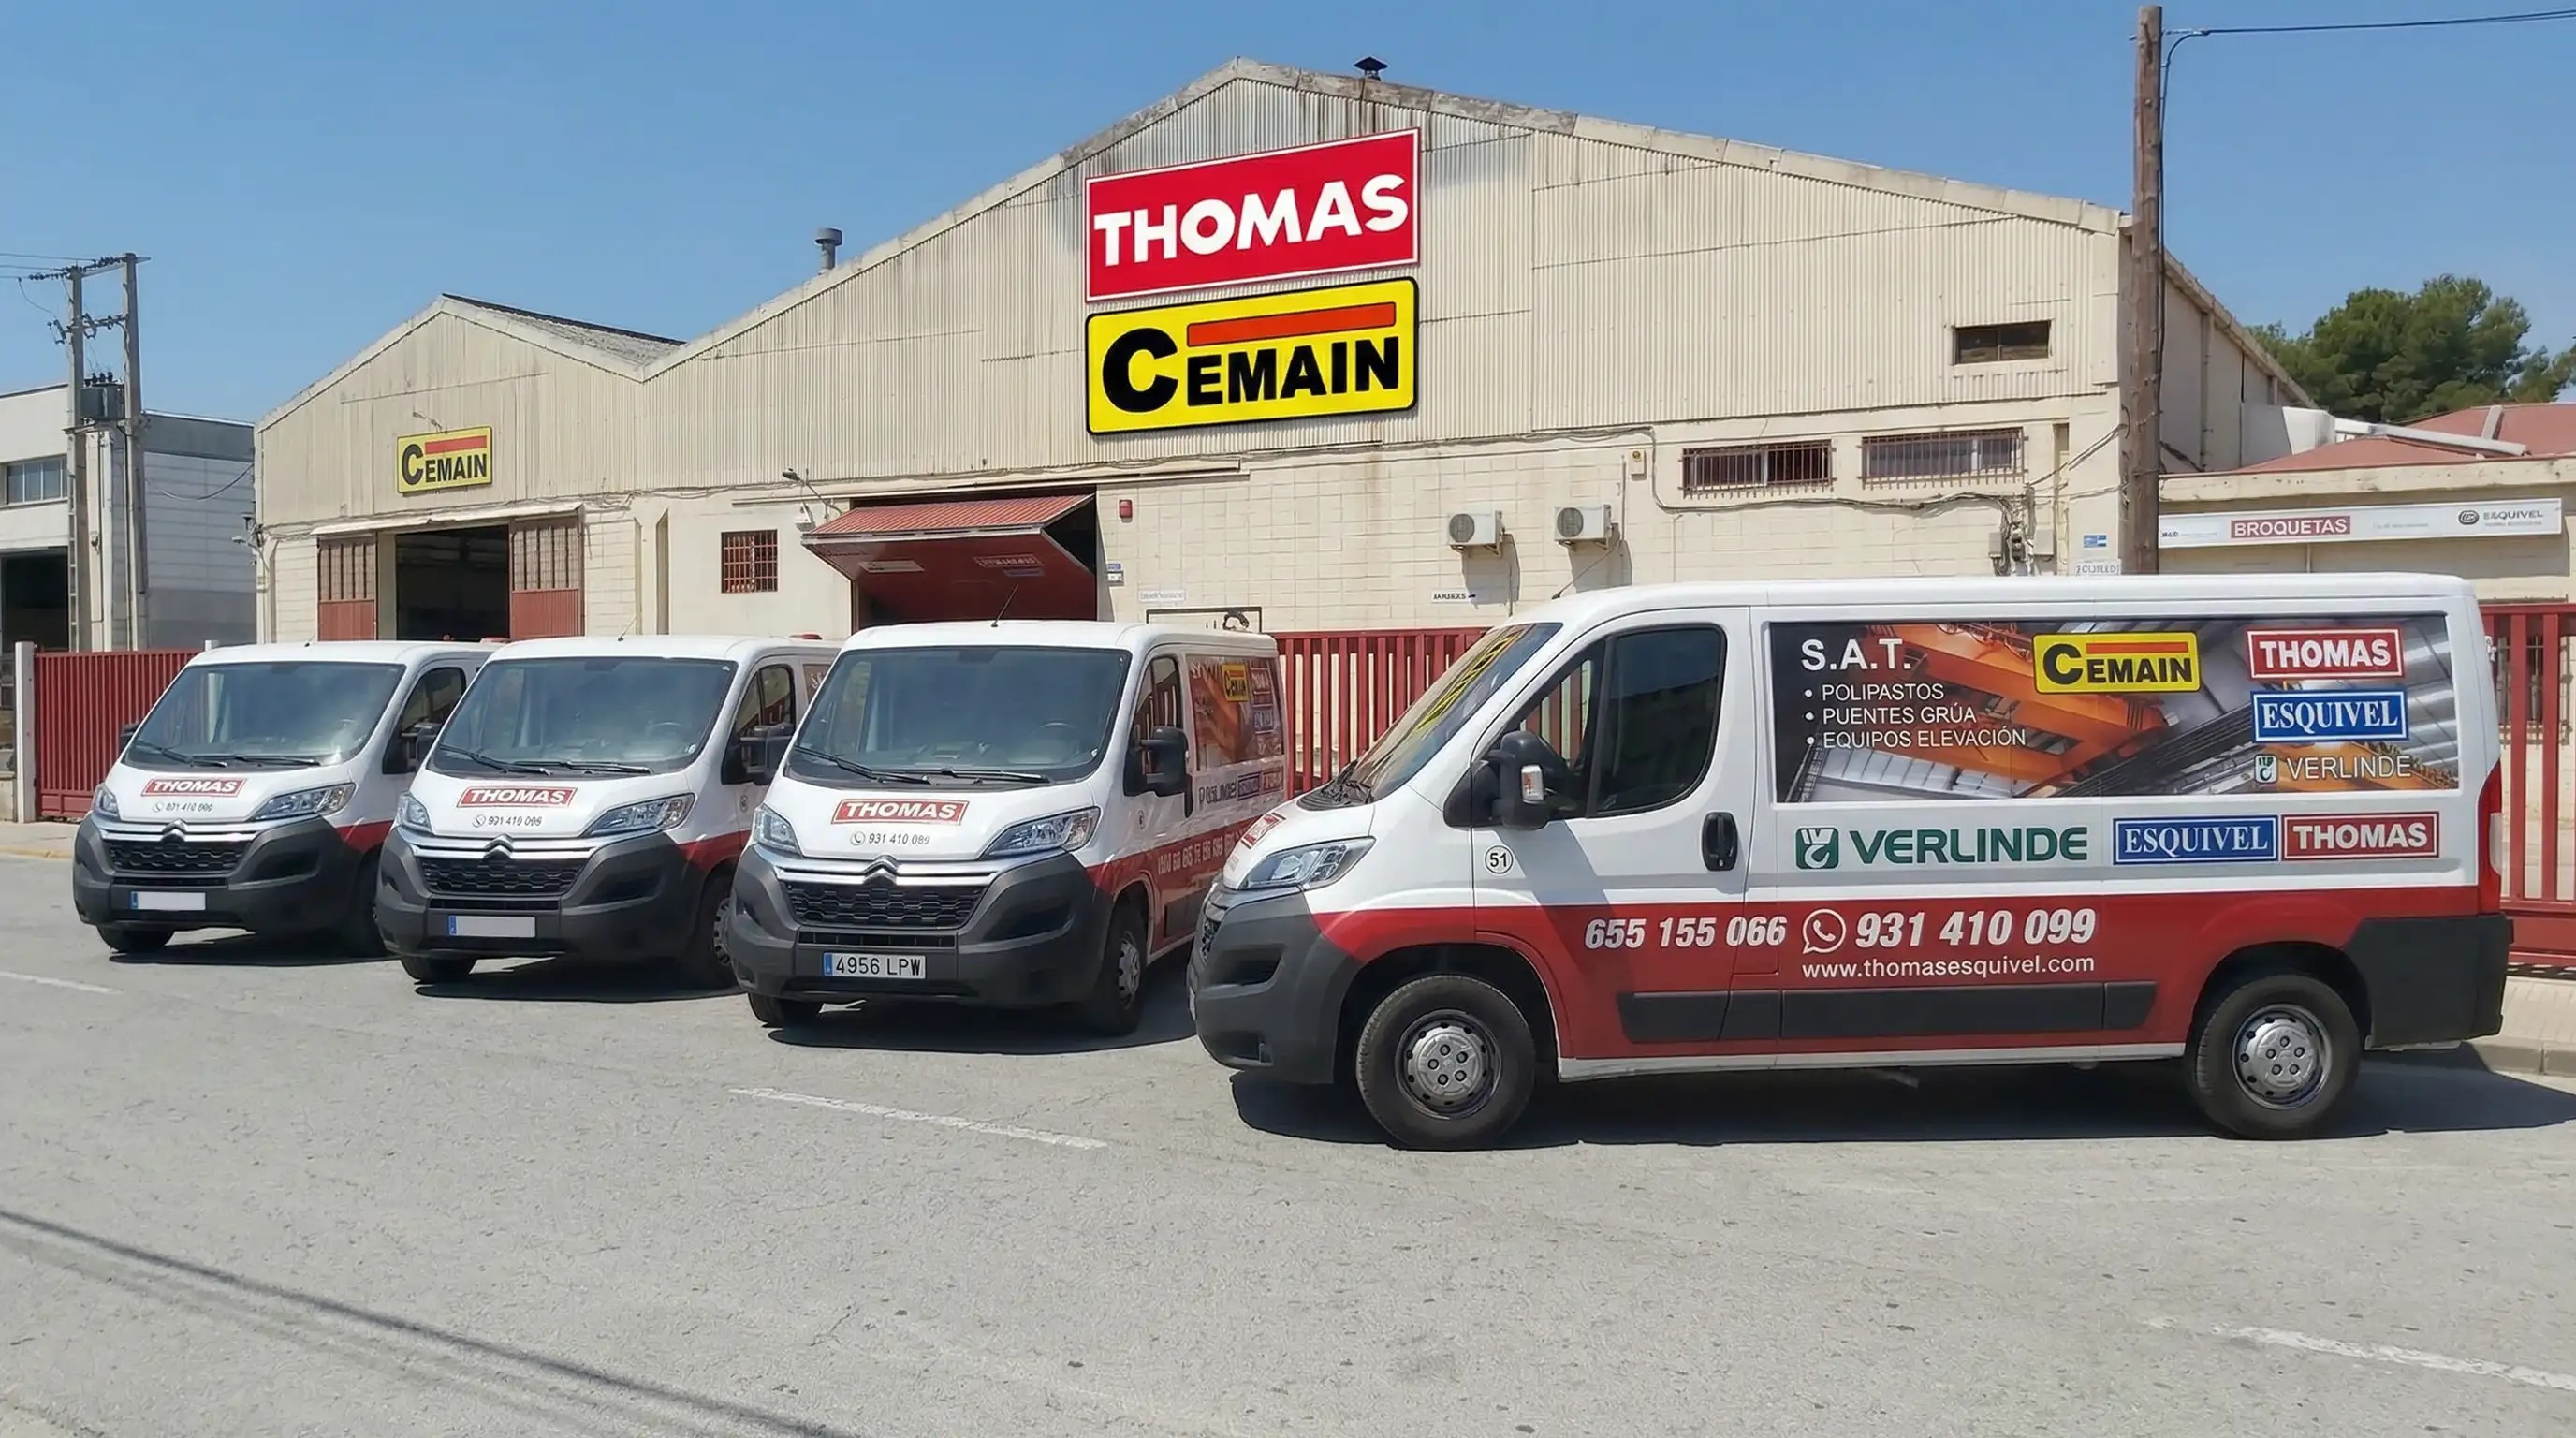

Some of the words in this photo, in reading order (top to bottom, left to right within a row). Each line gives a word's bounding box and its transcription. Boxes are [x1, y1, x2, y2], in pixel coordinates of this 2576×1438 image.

[1093, 174, 1409, 267] THOMAS
[1102, 327, 1399, 414] CEMAIN
[401, 443, 488, 486] CEMAIN
[2233, 518, 2349, 537] BROQUETAS
[1801, 638, 1911, 672] S.A.T.
[2042, 642, 2193, 686] CEMAIN
[2259, 638, 2392, 668] THOMAS
[1822, 683, 1945, 702] POLIPASTOS
[1822, 707, 1915, 725] PUENTES
[1920, 702, 1977, 724] GRÚA
[2261, 699, 2398, 734] ESQUIVEL
[1822, 730, 1912, 749] EQUIPOS
[1917, 726, 2027, 747] ELEVACIÓN
[2286, 755, 2413, 781] VERLINDE
[153, 779, 239, 793] THOMAS
[470, 789, 566, 805] THOMAS
[845, 801, 958, 820] THOMAS
[869, 833, 886, 844] 931
[889, 833, 909, 845] 410
[1849, 827, 2088, 865] VERLINDE
[2123, 825, 2269, 859] ESQUIVEL
[2291, 822, 2428, 851] THOMAS
[1489, 852, 1509, 868] 51
[1584, 917, 1647, 950] 655
[1658, 917, 1718, 948] 155
[1725, 915, 1788, 946] 066
[1855, 911, 1925, 948] 931
[1939, 909, 2013, 946] 410
[2023, 907, 2097, 945] 099
[835, 955, 881, 976] 4956
[886, 957, 921, 976] LPW
[1801, 954, 2096, 979] www.thomasesquivel.com
